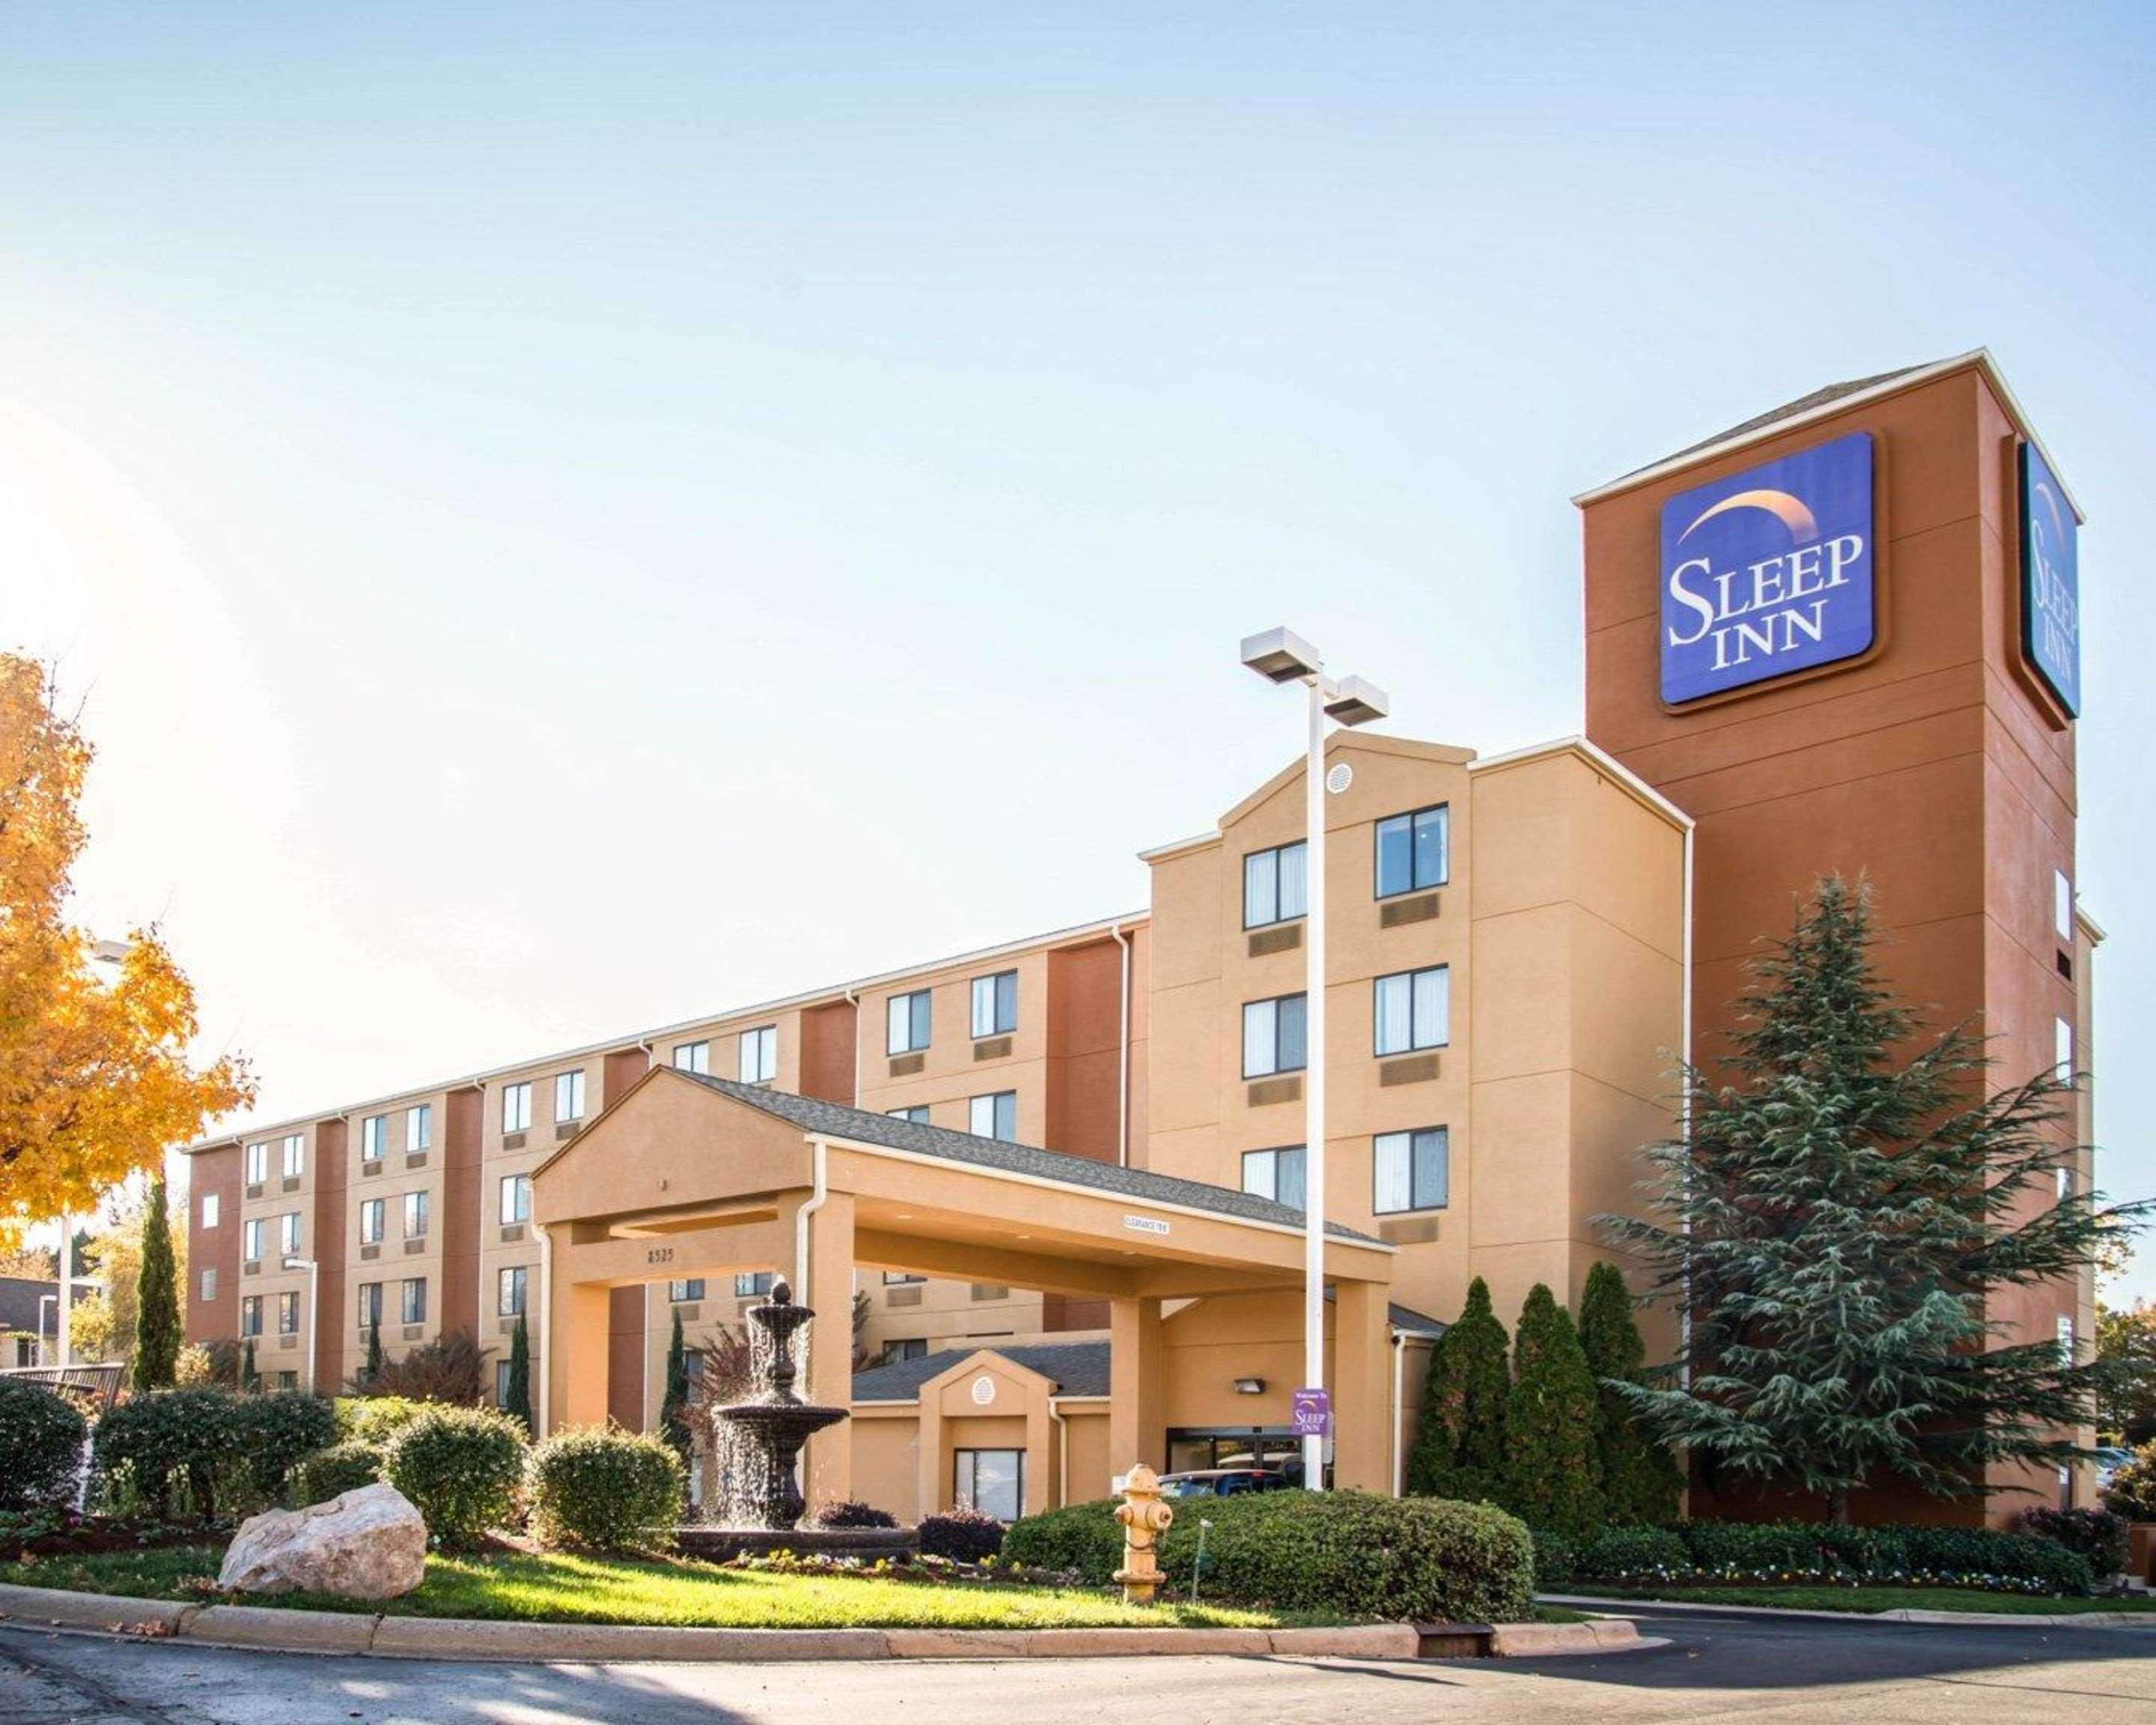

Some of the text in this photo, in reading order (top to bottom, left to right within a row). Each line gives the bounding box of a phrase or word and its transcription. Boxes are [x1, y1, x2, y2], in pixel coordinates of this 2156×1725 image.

[1668, 534, 1864, 648] SLEEP
[2032, 518, 2077, 647] SLEEP
[1710, 599, 1829, 672] INN
[2044, 612, 2072, 685] INN
[1294, 1409, 1326, 1426] SLEEP
